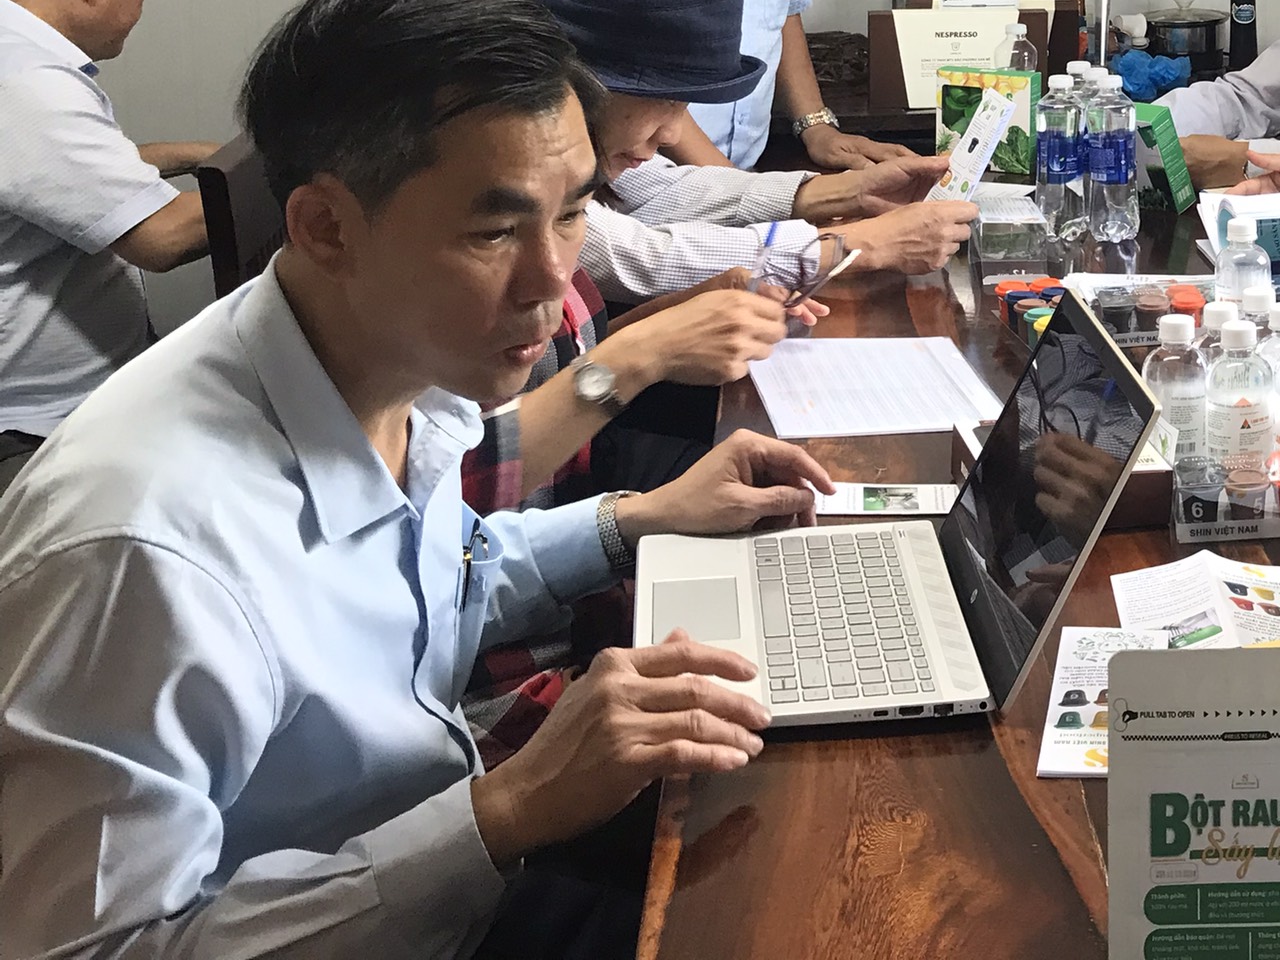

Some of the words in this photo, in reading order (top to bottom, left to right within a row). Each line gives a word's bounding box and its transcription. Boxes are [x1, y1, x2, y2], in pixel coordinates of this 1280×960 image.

[1191, 502, 1204, 519] 6
[1253, 496, 1263, 514] 5
[1189, 528, 1212, 537] SHIN
[1214, 525, 1235, 536] VIỆT
[1238, 525, 1259, 534] NAM
[1140, 710, 1156, 719] PULL
[1155, 710, 1168, 718] TAB
[1167, 710, 1177, 718] TO
[1177, 710, 1195, 718] OPEN
[1150, 792, 1225, 857] BỘT
[1200, 828, 1255, 879] Sấy
